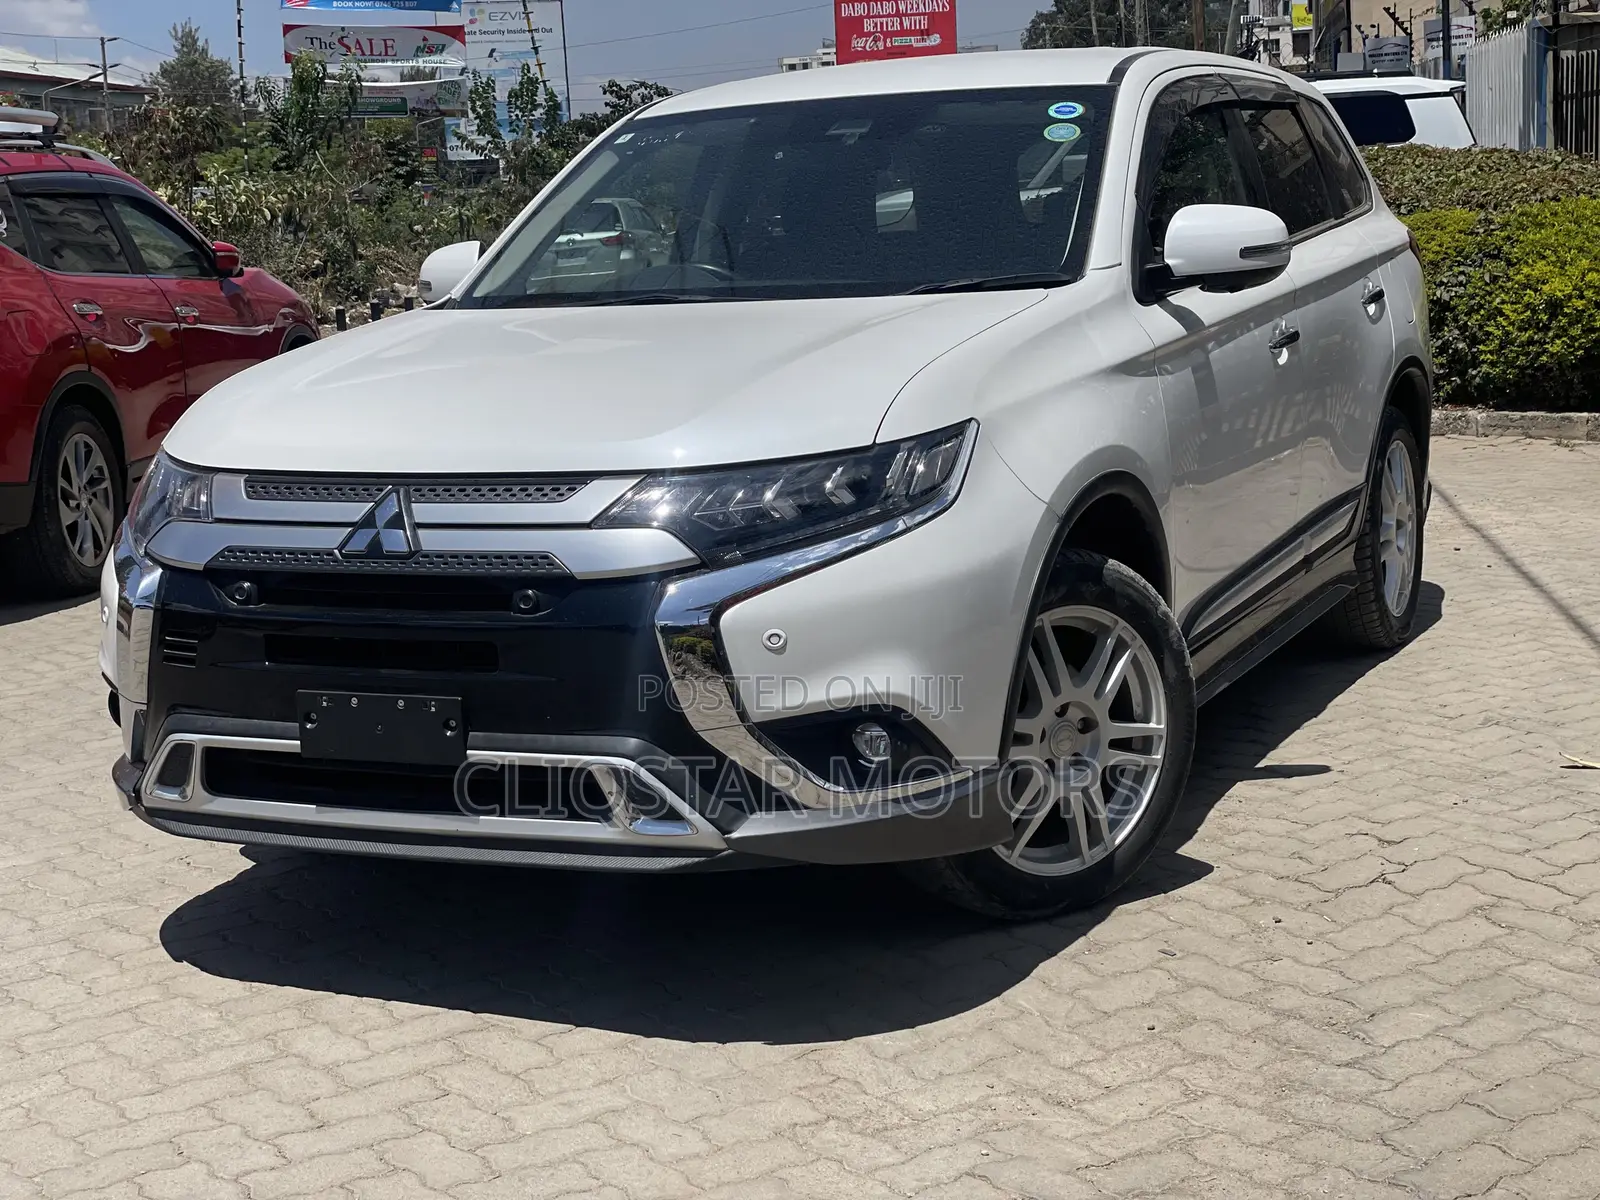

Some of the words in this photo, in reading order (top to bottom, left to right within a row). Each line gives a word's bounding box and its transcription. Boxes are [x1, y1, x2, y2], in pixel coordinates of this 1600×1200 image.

[332, 0, 353, 8] BOOK
[841, 2, 868, 17] DABO
[870, 1, 896, 16] DABO
[898, 0, 950, 14] WEEKDAYS
[863, 17, 901, 32] BETTER
[902, 15, 929, 30] WITH
[478, 28, 505, 36] Security
[305, 36, 336, 50] The
[337, 36, 398, 57] SALE
[886, 38, 892, 47] &
[893, 37, 913, 45] PIZZA
